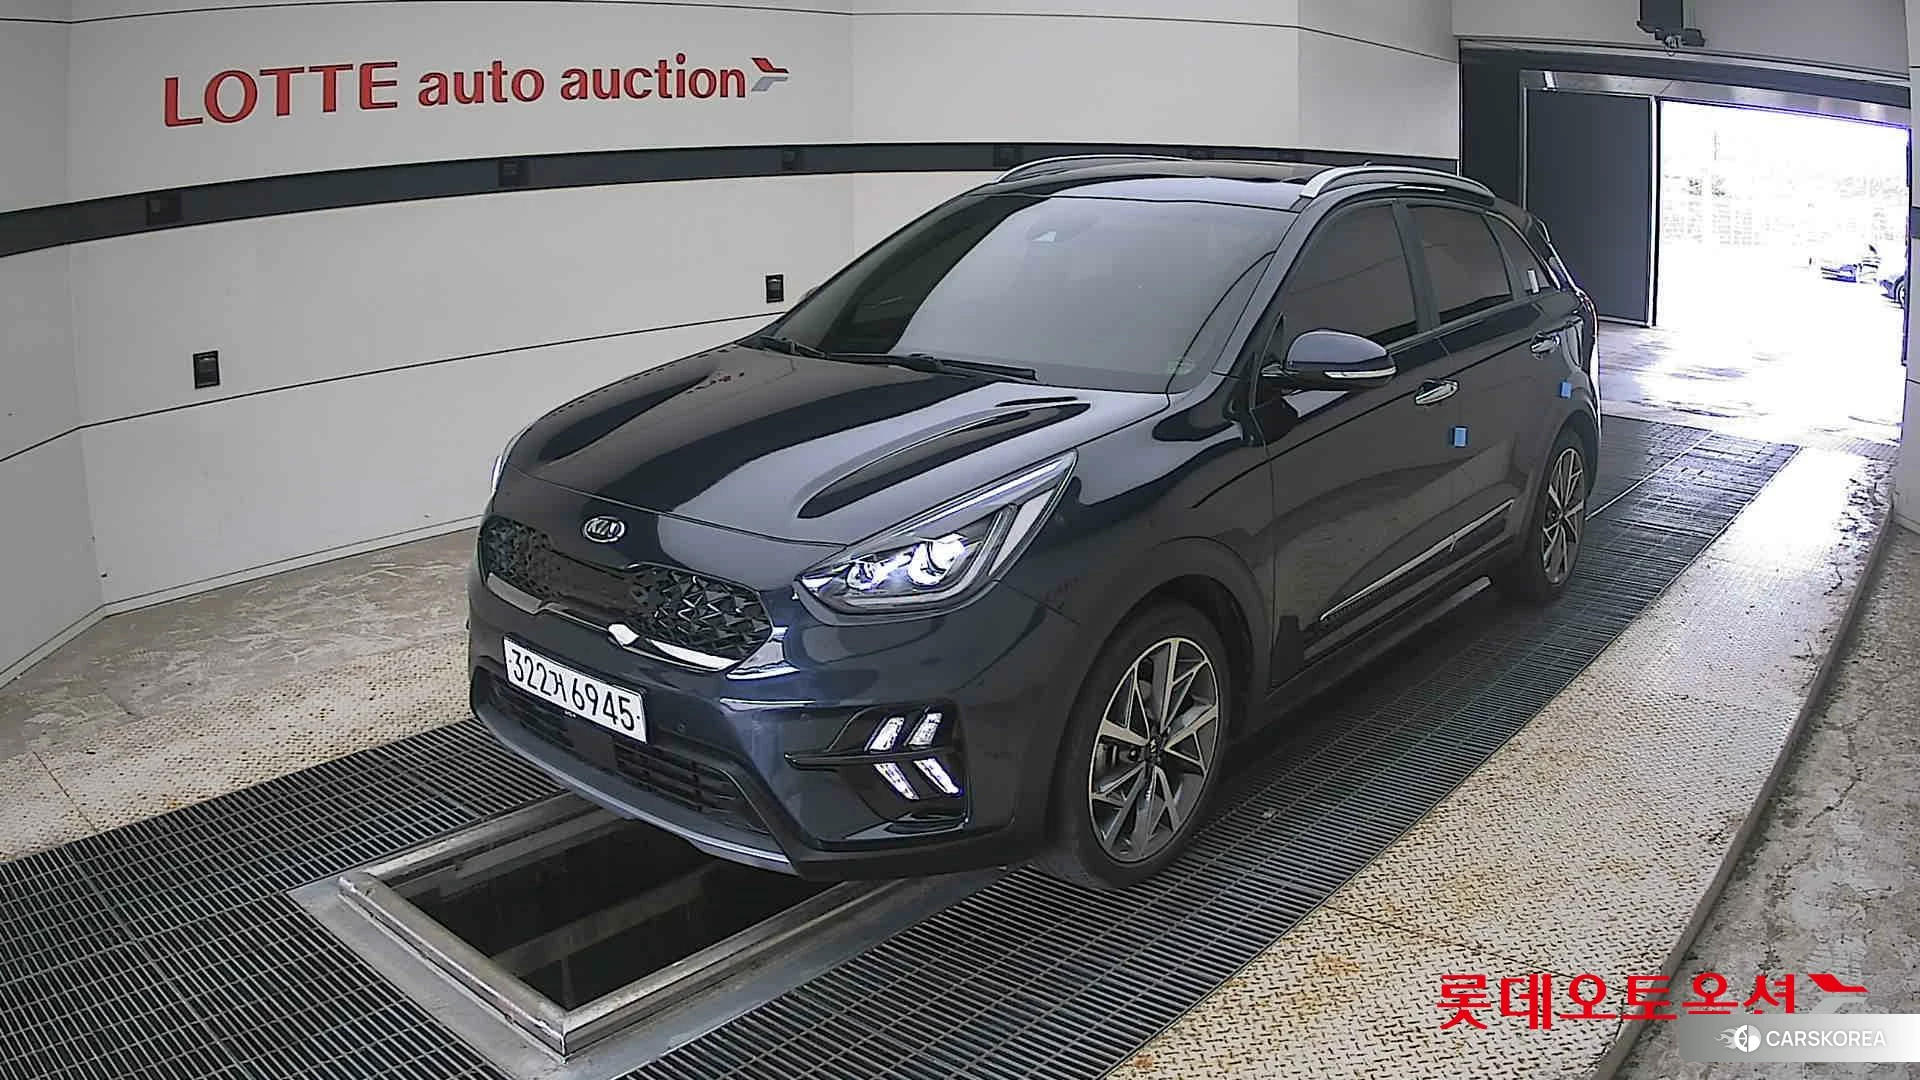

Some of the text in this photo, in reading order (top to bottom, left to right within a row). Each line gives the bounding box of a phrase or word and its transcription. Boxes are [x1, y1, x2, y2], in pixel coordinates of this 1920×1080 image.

[163, 52, 747, 127] LOTTE auto auction
